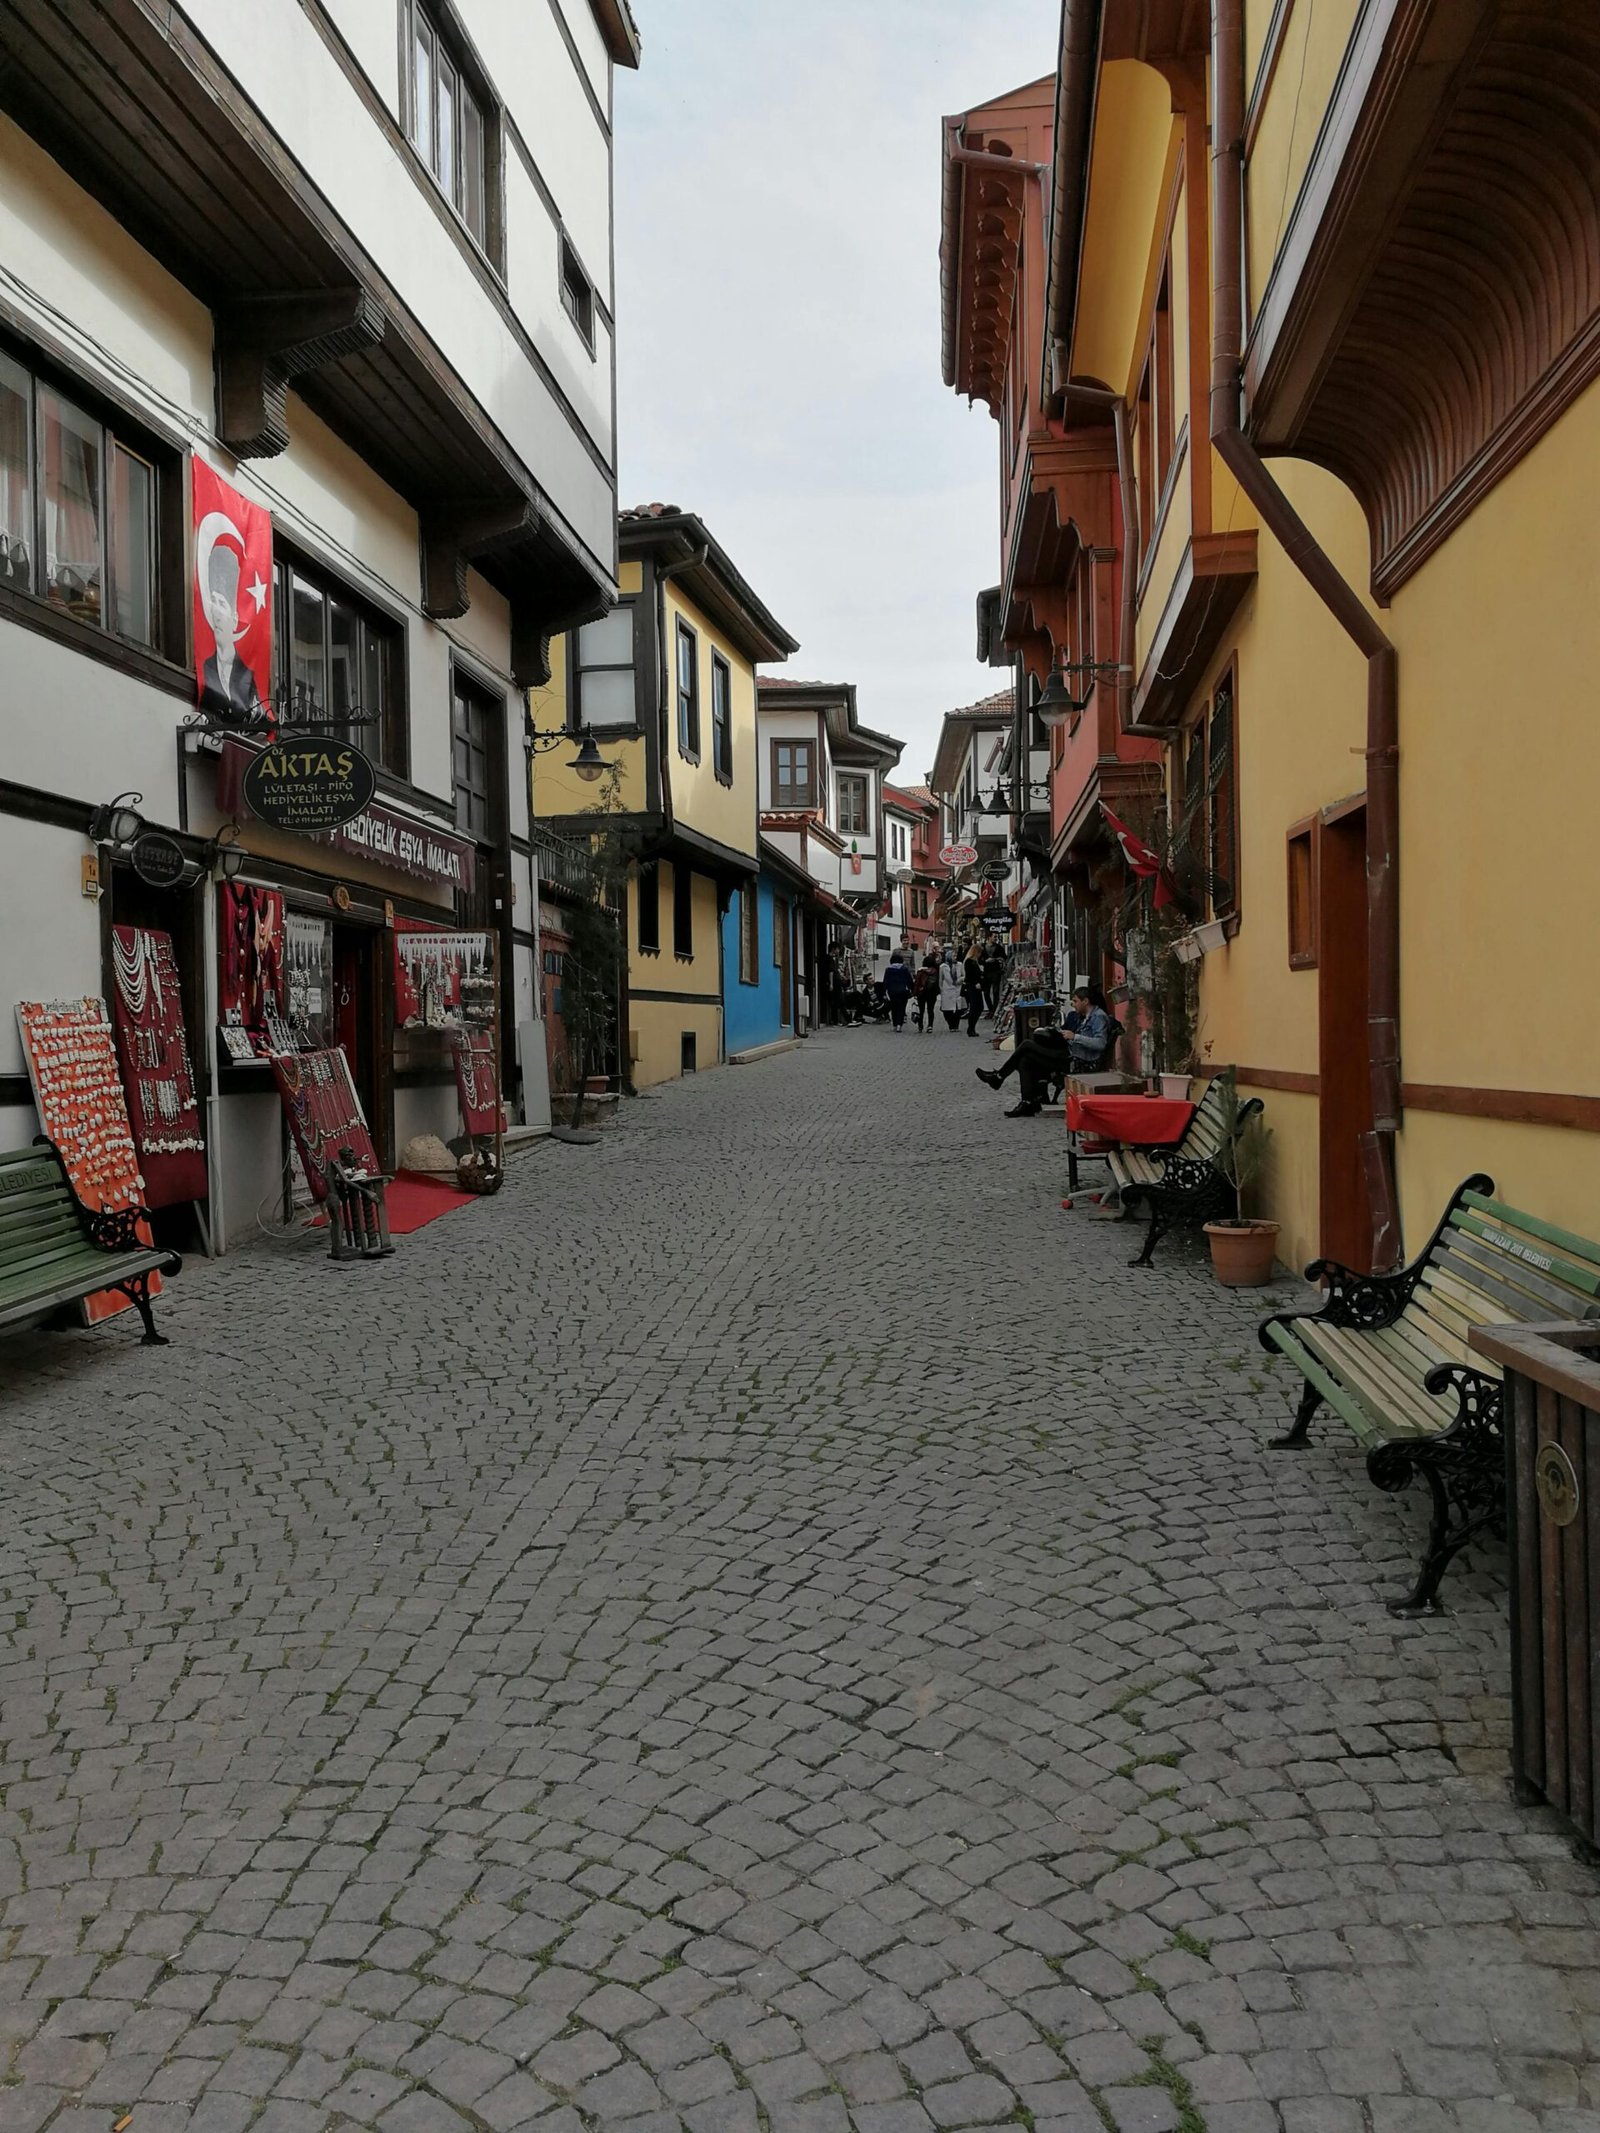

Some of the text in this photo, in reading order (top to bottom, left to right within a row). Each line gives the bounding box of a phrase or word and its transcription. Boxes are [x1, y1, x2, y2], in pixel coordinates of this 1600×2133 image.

[258, 751, 354, 781] AKTAŞ
[265, 783, 318, 794] LÜLETAŞI
[328, 780, 354, 791] PİPO
[263, 793, 356, 805] HEDİYELİK EŞYA
[287, 805, 334, 816] İMALATI
[399, 830, 425, 869] EŞYA
[427, 837, 461, 880] İMALATI
[989, 925, 1007, 933] Cafe
